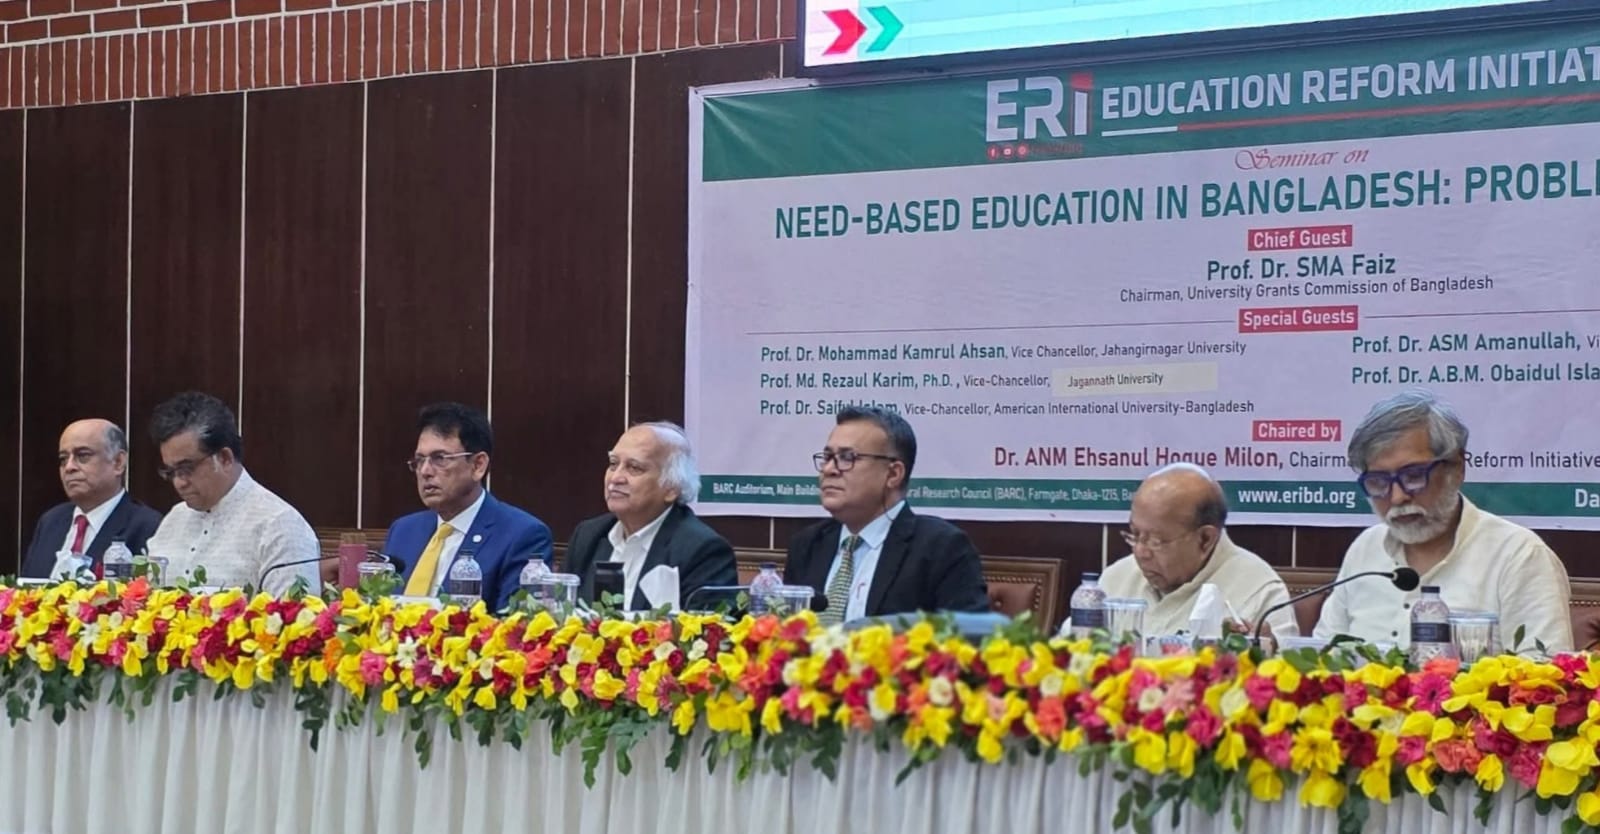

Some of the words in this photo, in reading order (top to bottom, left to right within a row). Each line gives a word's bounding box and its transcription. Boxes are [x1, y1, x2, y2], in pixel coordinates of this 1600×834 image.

[1102, 72, 1291, 119] EDUCATION
[1302, 58, 1455, 104] REFORM
[1467, 46, 1600, 91] INITIAT
[1234, 148, 1339, 170] Seminar
[1343, 149, 1370, 164] on
[775, 198, 960, 239] NEED-BASED
[971, 187, 1143, 230] EDUCATION
[1156, 184, 1188, 220] IN
[1201, 168, 1451, 218] BANGLADESH:
[1464, 159, 1600, 204] PROBL
[1253, 230, 1295, 249] Chief
[1300, 229, 1347, 246] Guest
[1207, 259, 1253, 281] Prof.
[1261, 258, 1289, 279] Dr.
[1296, 255, 1344, 277] SMA
[1352, 253, 1396, 275] Faiz
[1120, 288, 1183, 303] Chairman,
[1187, 284, 1251, 300] University
[1256, 283, 1300, 297] Grants
[1304, 280, 1388, 296] Commission
[1392, 278, 1407, 292] of
[1410, 275, 1494, 295] Bangladesh
[1243, 309, 1297, 330] Special
[1302, 309, 1355, 326] Guests
[761, 347, 791, 362] Prof.
[796, 346, 814, 361] Dr.
[818, 345, 897, 361] Mohammad
[902, 343, 954, 360] Kamrul
[959, 343, 1008, 360] Ahsan,
[1011, 346, 1033, 358] Vice
[1036, 345, 1099, 359] Chancellor,
[1101, 342, 1184, 358] Jahangirnagar
[1187, 341, 1247, 355] University
[1352, 336, 1392, 353] Prof.
[1398, 336, 1422, 352] Dr.
[1428, 334, 1468, 352] ASM
[1474, 331, 1581, 352] Amanullah,
[760, 373, 791, 388] Prof.
[796, 373, 817, 388] Md.
[822, 373, 867, 388] Rezaul
[872, 372, 918, 389] Karim,
[923, 374, 953, 387] Ph.D.
[964, 374, 1050, 388] Vice-Chancellor,
[1067, 376, 1115, 389] Jagannath
[1117, 373, 1164, 386] University
[1352, 367, 1392, 384] Prof.
[1398, 366, 1422, 383] Dr.
[1428, 365, 1484, 383] A.B.M.
[1490, 363, 1561, 382] Obaidul
[1568, 362, 1600, 381] Isla
[760, 400, 791, 415] Prof.
[795, 400, 813, 415] Dr.
[905, 403, 991, 416] Vice-Chancellor,
[994, 402, 1045, 415] American
[1049, 402, 1118, 415] International
[1122, 400, 1254, 416] University-Bangladesh
[1258, 423, 1315, 439] Chaired
[1320, 423, 1338, 441] by
[994, 447, 1019, 466] Dr.
[1025, 447, 1067, 466] ANM
[1074, 447, 1149, 466] Ehsanul
[1225, 447, 1283, 470] Milon,
[1289, 451, 1348, 468] Chairm
[1464, 451, 1523, 468] Reform
[1530, 451, 1600, 468] Initiative
[713, 483, 734, 494] BARC
[922, 487, 960, 498] Research
[962, 487, 992, 499] Council
[1028, 488, 1069, 503] Farmgate,
[1238, 487, 1356, 508] www.eribd.org
[1575, 488, 1600, 508] Da
